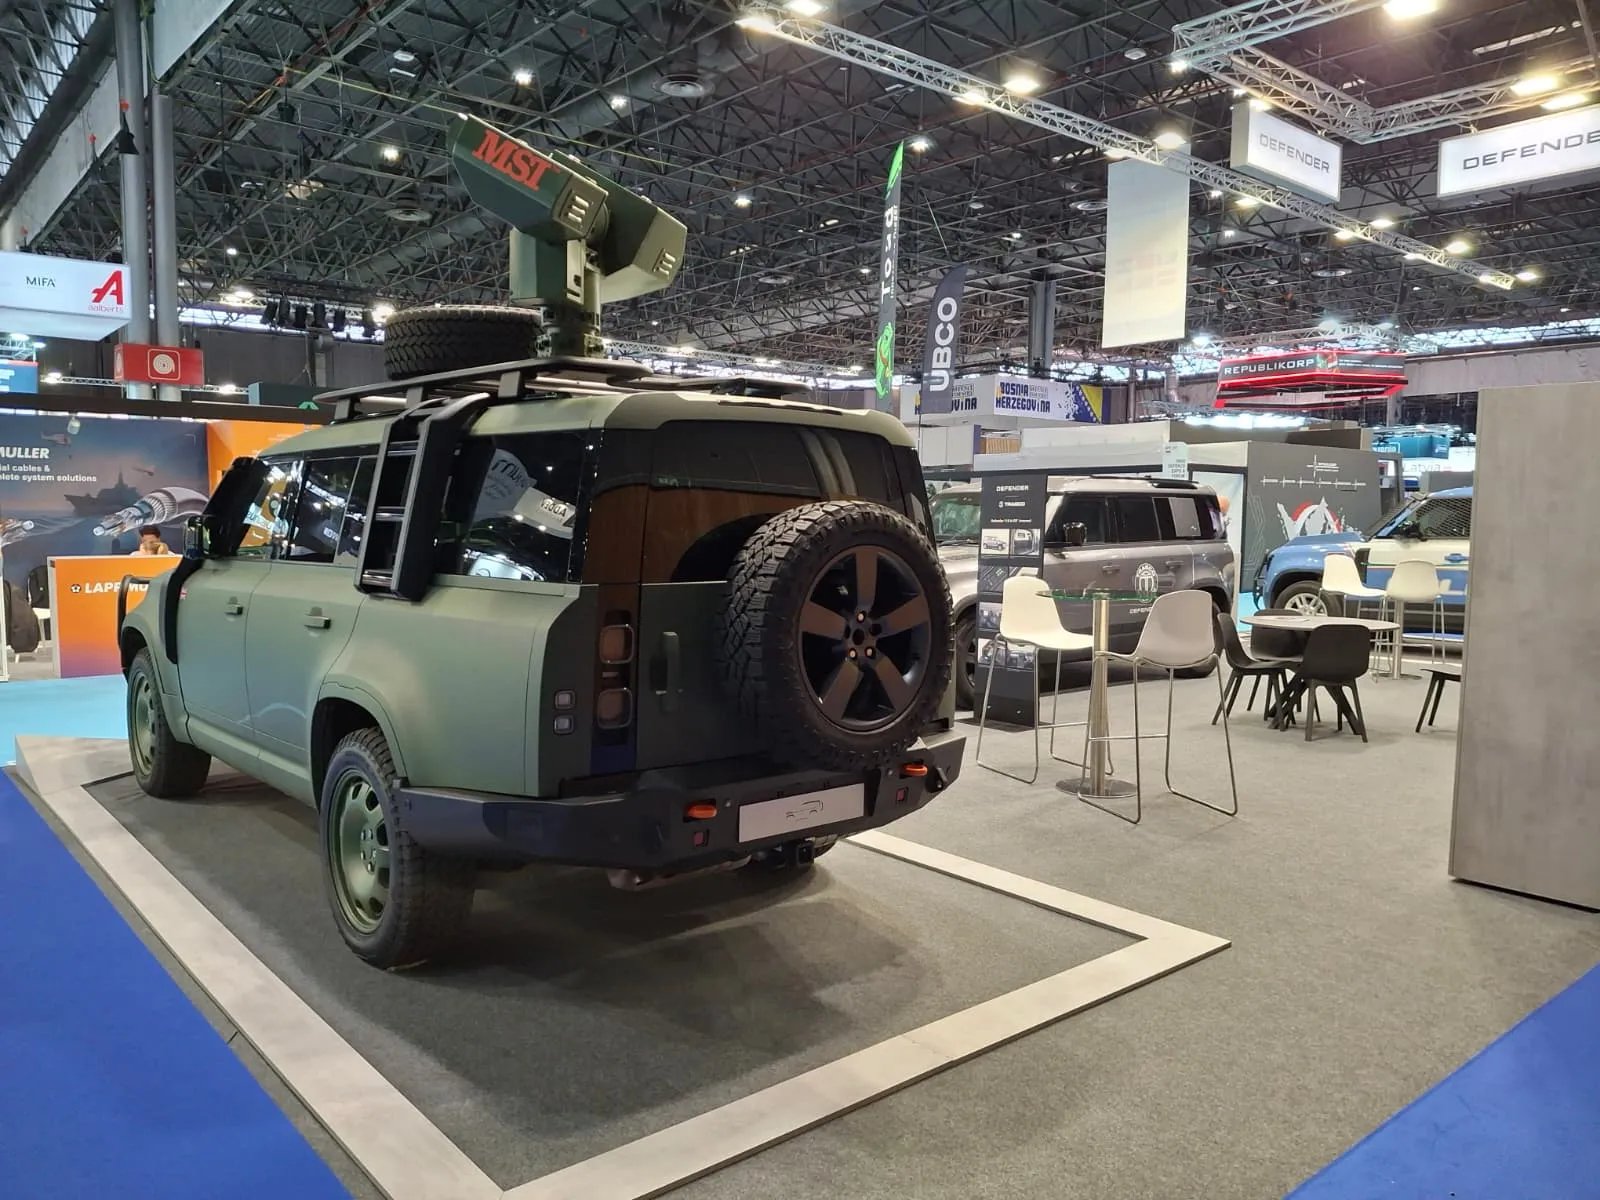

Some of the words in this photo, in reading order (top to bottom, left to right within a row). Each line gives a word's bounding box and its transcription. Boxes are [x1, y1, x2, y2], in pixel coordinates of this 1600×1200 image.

[472, 129, 552, 191] MSI
[1260, 134, 1330, 173] DEFENDER
[26, 276, 55, 288] MIFA
[929, 297, 957, 392] UBCO
[1224, 358, 1315, 375] REPUBLIKORP
[995, 396, 1050, 412] HERZEGOVINA
[12, 464, 42, 472] cables
[22, 474, 54, 483] system
[57, 474, 97, 482] solutions
